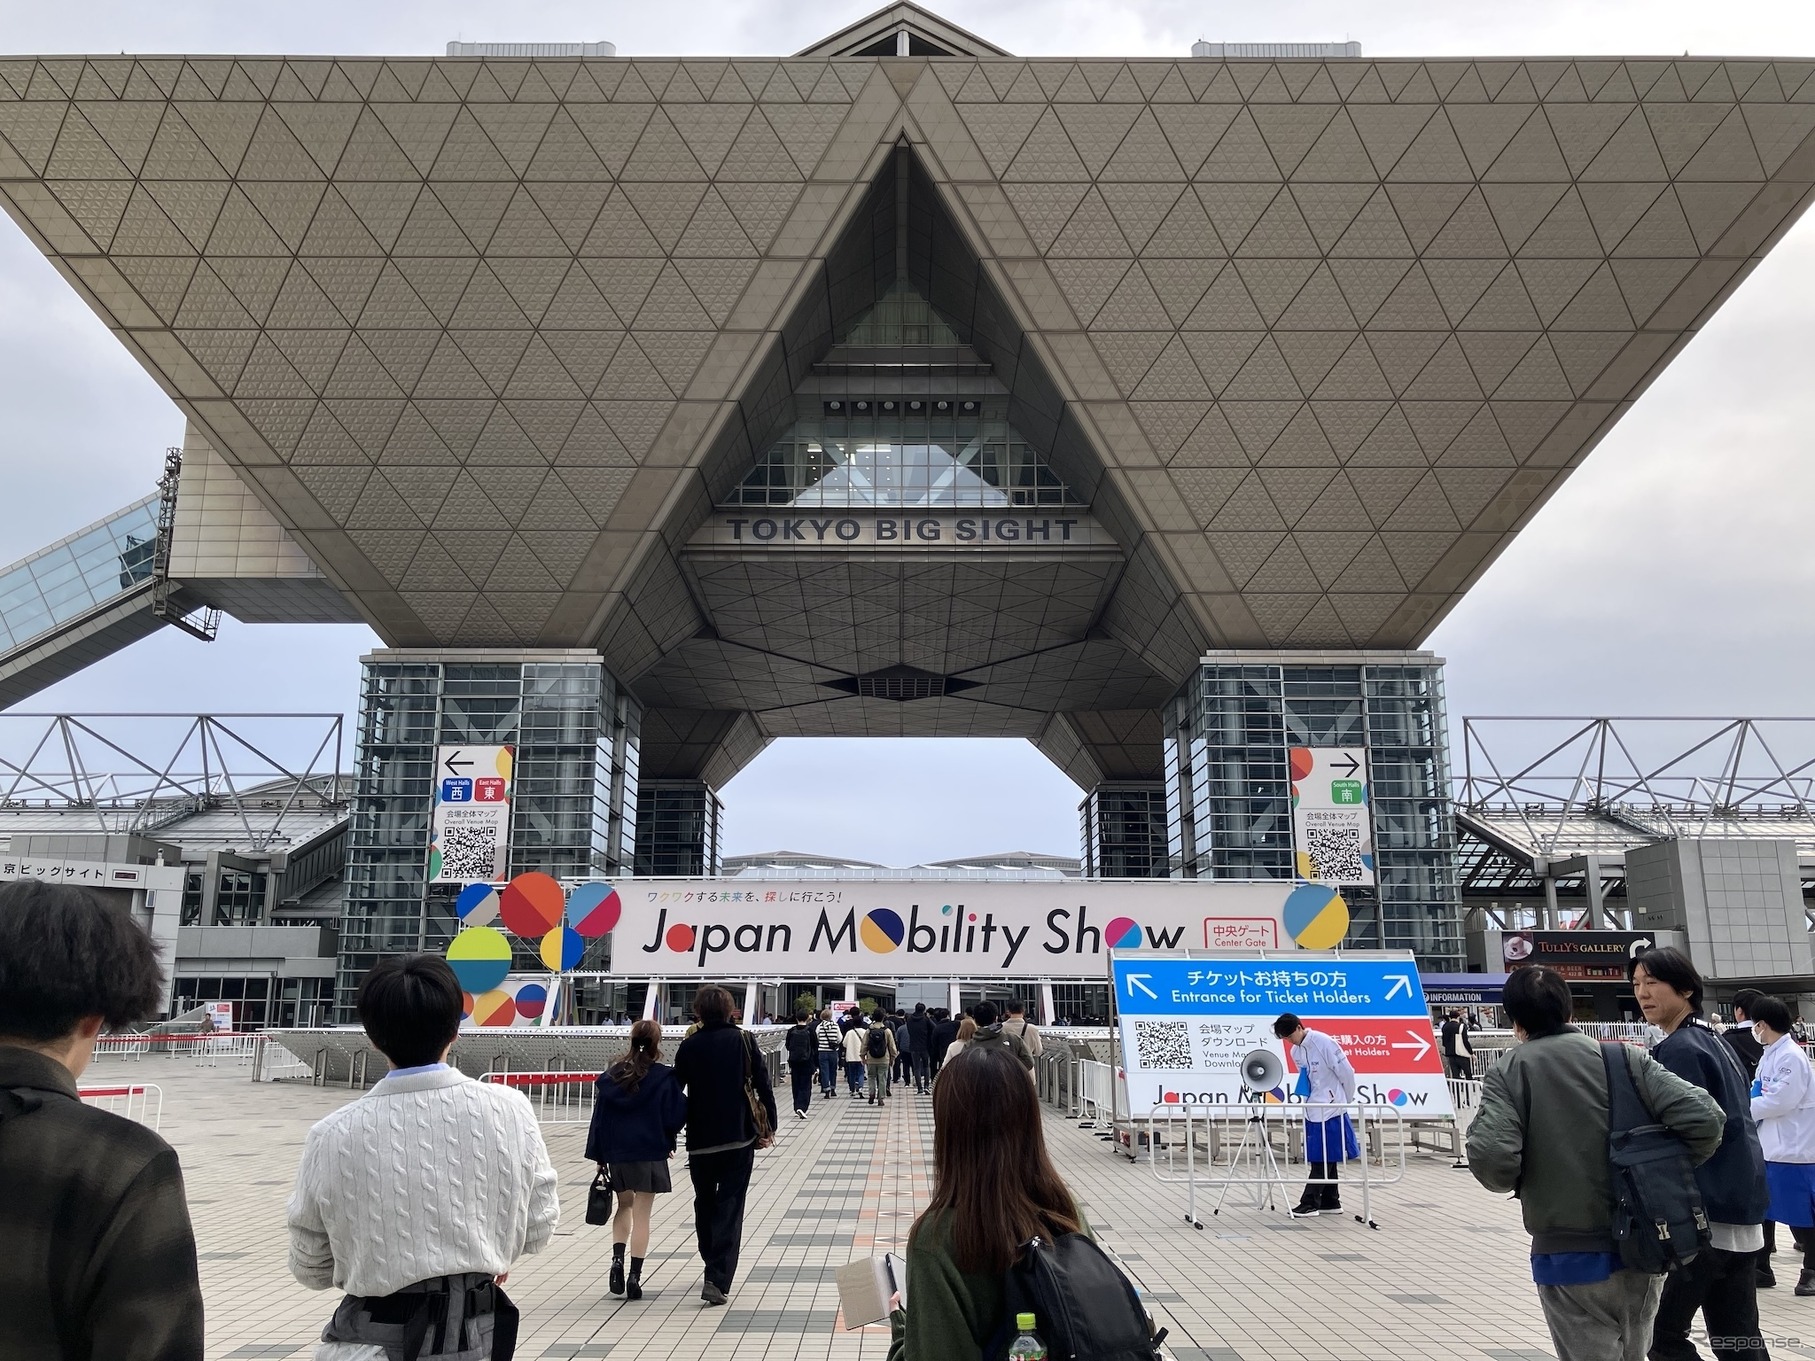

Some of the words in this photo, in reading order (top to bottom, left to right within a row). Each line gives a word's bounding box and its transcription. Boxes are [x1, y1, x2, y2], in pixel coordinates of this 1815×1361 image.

[726, 519, 861, 541] TOKYO
[875, 519, 941, 541] BIG
[956, 518, 1078, 541] SIGHT
[451, 787, 463, 800] 西
[484, 786, 495, 800] 東
[1341, 788, 1353, 802] 南
[447, 809, 498, 818] 会場全体マップ
[1306, 811, 1358, 821] 会場全体マップ
[642, 908, 792, 968] Japan
[808, 904, 1031, 969] Mobility
[1042, 905, 1186, 954] Show
[1213, 925, 1270, 937] 中央ゲート
[1214, 938, 1243, 947] Center
[1245, 938, 1267, 947] Gate
[1580, 943, 1626, 953] GALLERY
[1187, 970, 1348, 988] チケットお持ちの方
[1171, 989, 1236, 1004] Entrance
[1239, 989, 1262, 1004] for
[1265, 989, 1309, 1004] Ticket
[1316, 989, 1371, 1004] Holders
[1430, 993, 1482, 1002] INFORMATION
[1199, 1023, 1255, 1034] 会場マップ
[1201, 1036, 1268, 1047] ダウンロード
[1202, 1050, 1230, 1058] Venue
[1354, 1047, 1391, 1056] Holders
[1204, 1059, 1241, 1068] Downlo
[1153, 1084, 1229, 1112] Japan
[1357, 1084, 1428, 1107] Show
